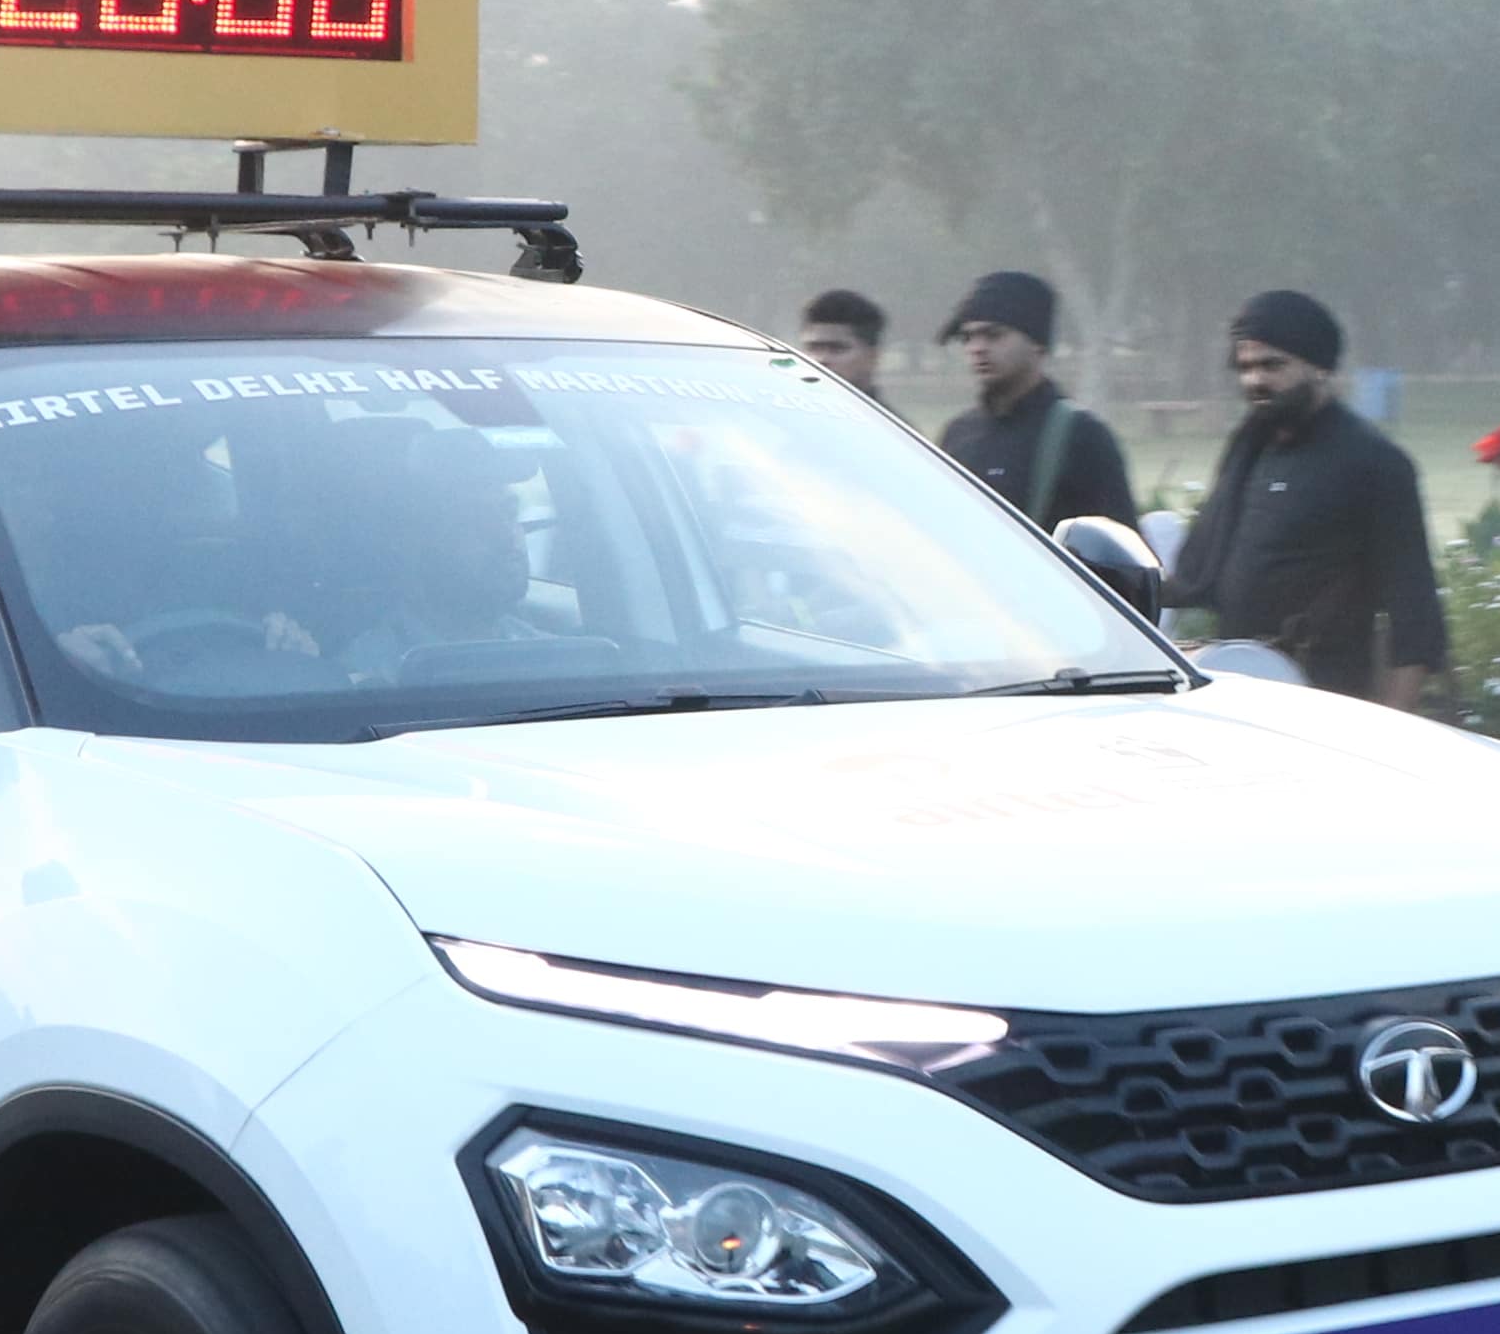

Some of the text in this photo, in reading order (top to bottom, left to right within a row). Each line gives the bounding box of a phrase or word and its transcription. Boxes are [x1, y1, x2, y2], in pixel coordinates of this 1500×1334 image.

[191, 370, 370, 401] DELHI
[375, 369, 504, 393] HALF
[514, 369, 756, 405] MARATHON
